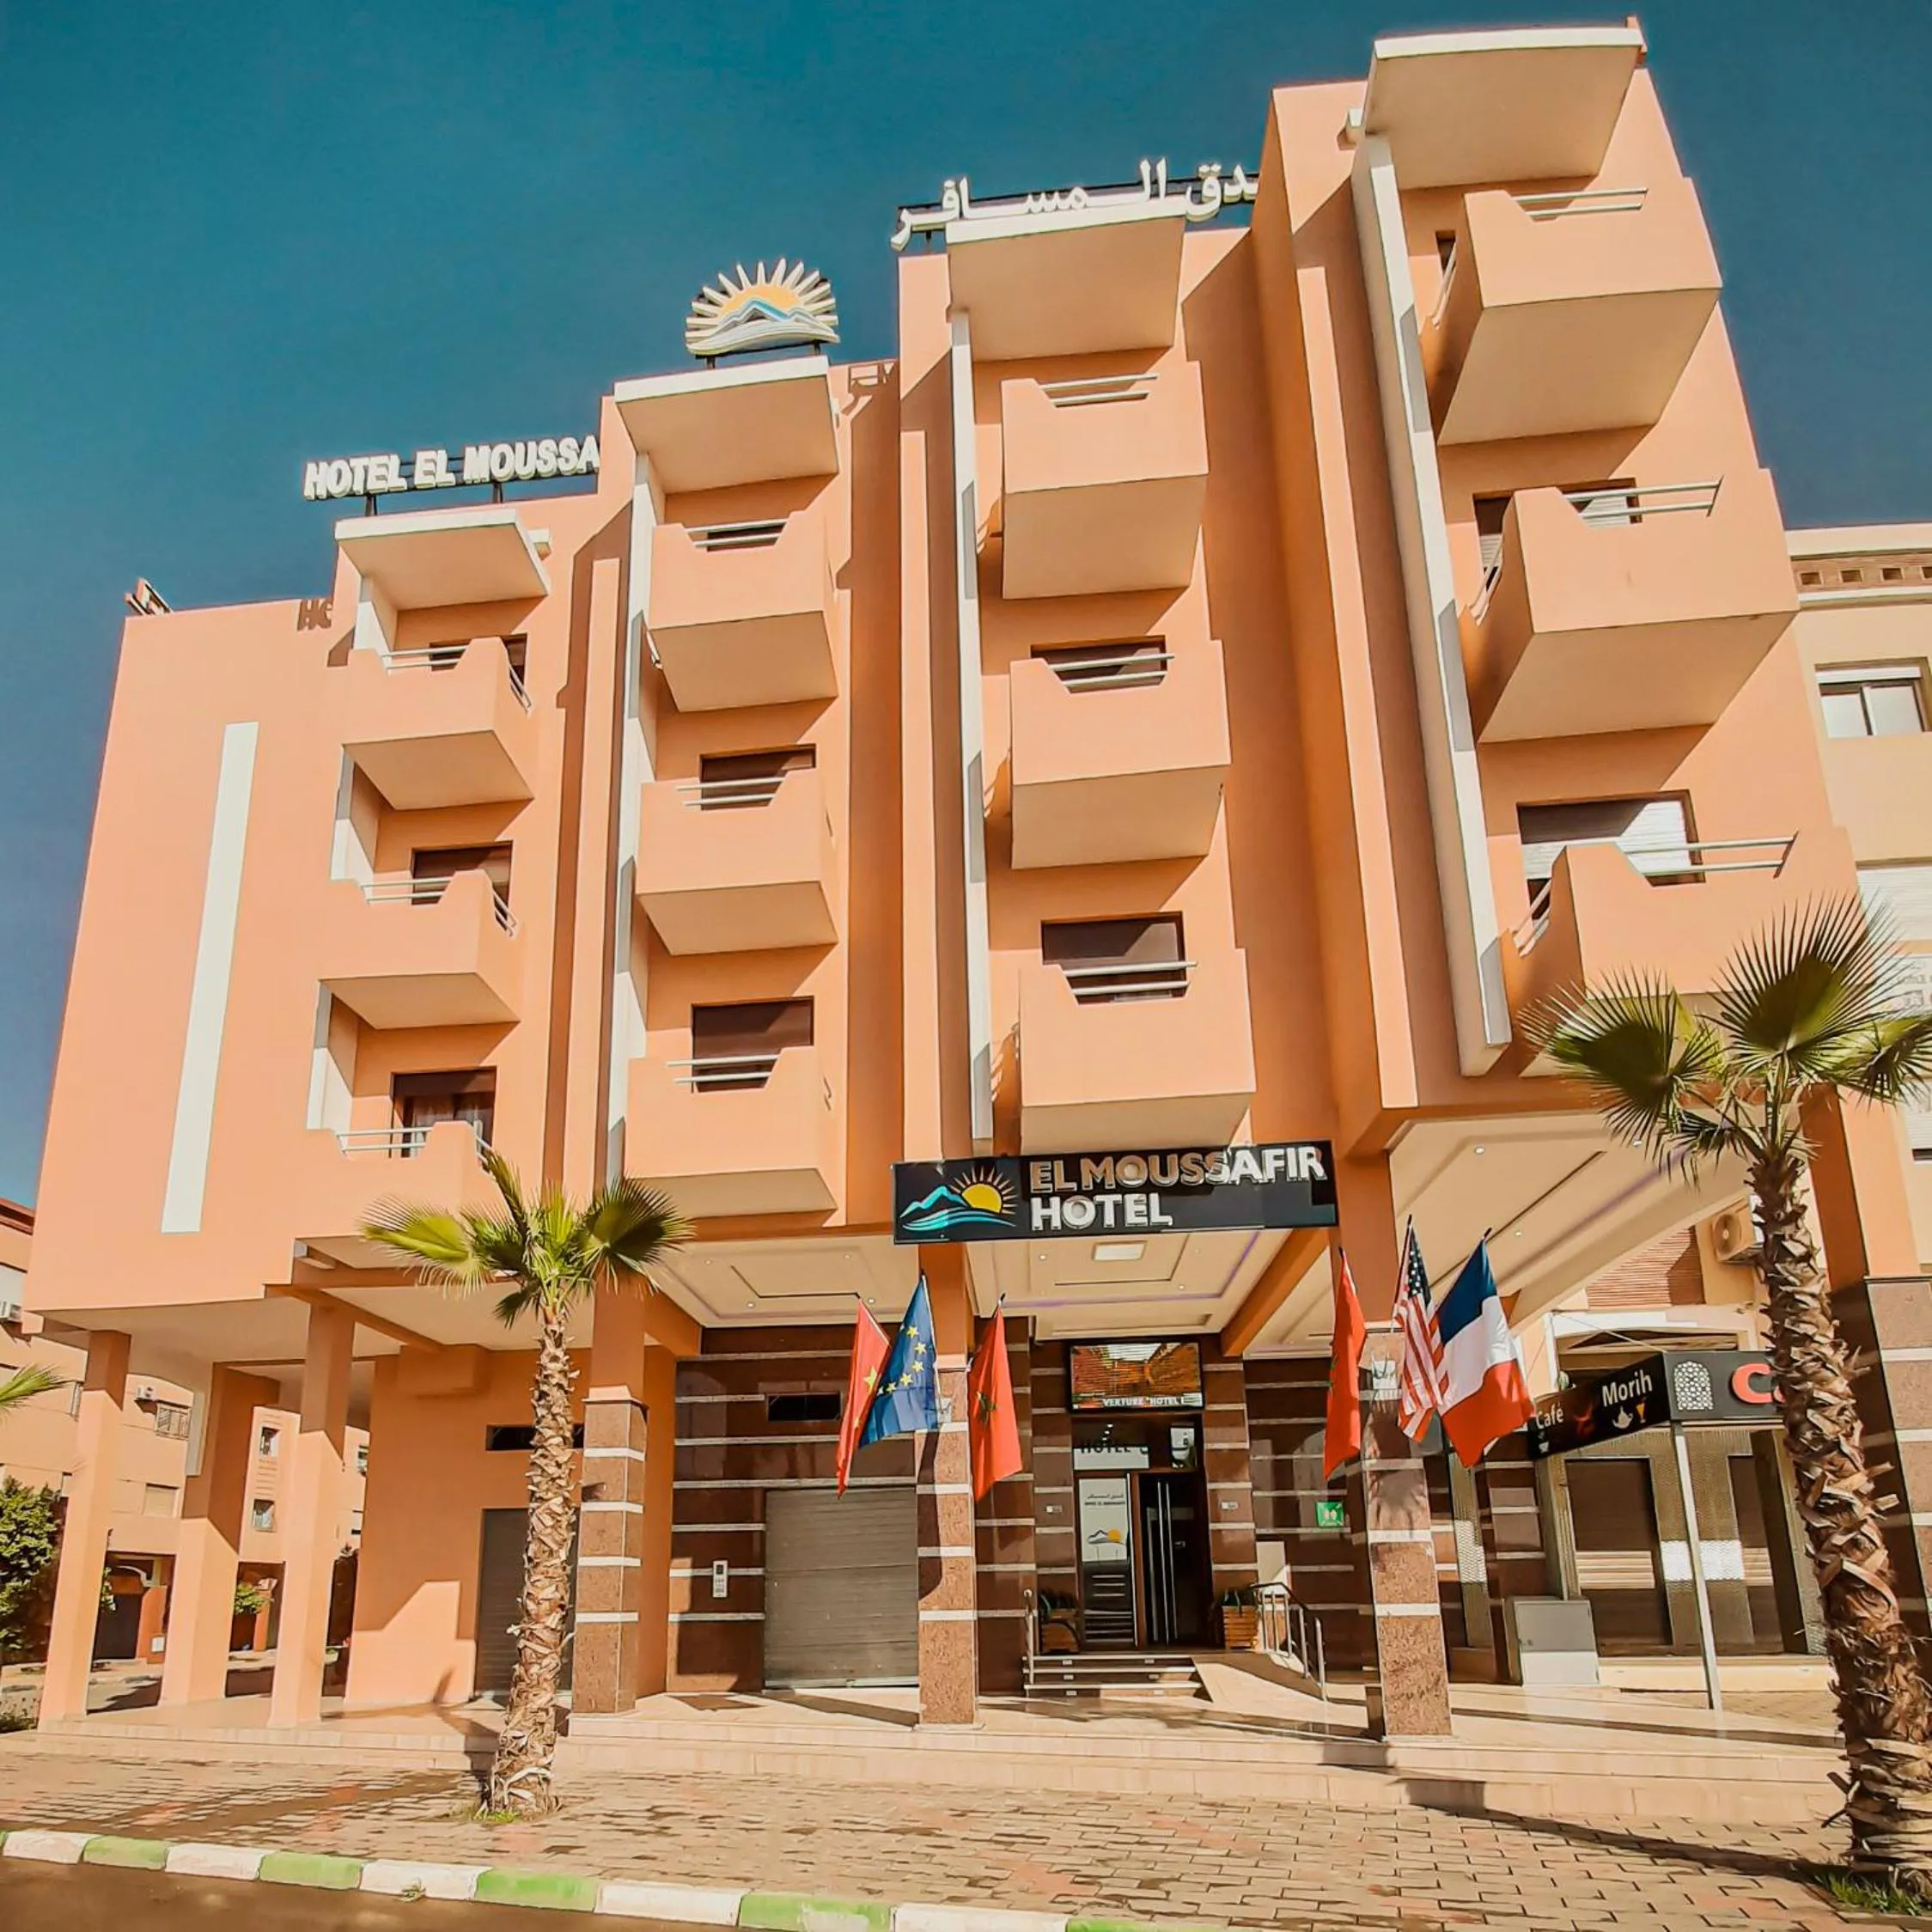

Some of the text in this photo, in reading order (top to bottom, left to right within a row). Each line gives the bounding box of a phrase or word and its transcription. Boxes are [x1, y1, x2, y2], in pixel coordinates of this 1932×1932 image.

[304, 454, 407, 500] HOTEL
[414, 449, 455, 489] EL
[1031, 1145, 1327, 1193] EL MOUSSAFIR
[1031, 1192, 1173, 1231] HOTEL
[1535, 1369, 1654, 1430] Café Morih
